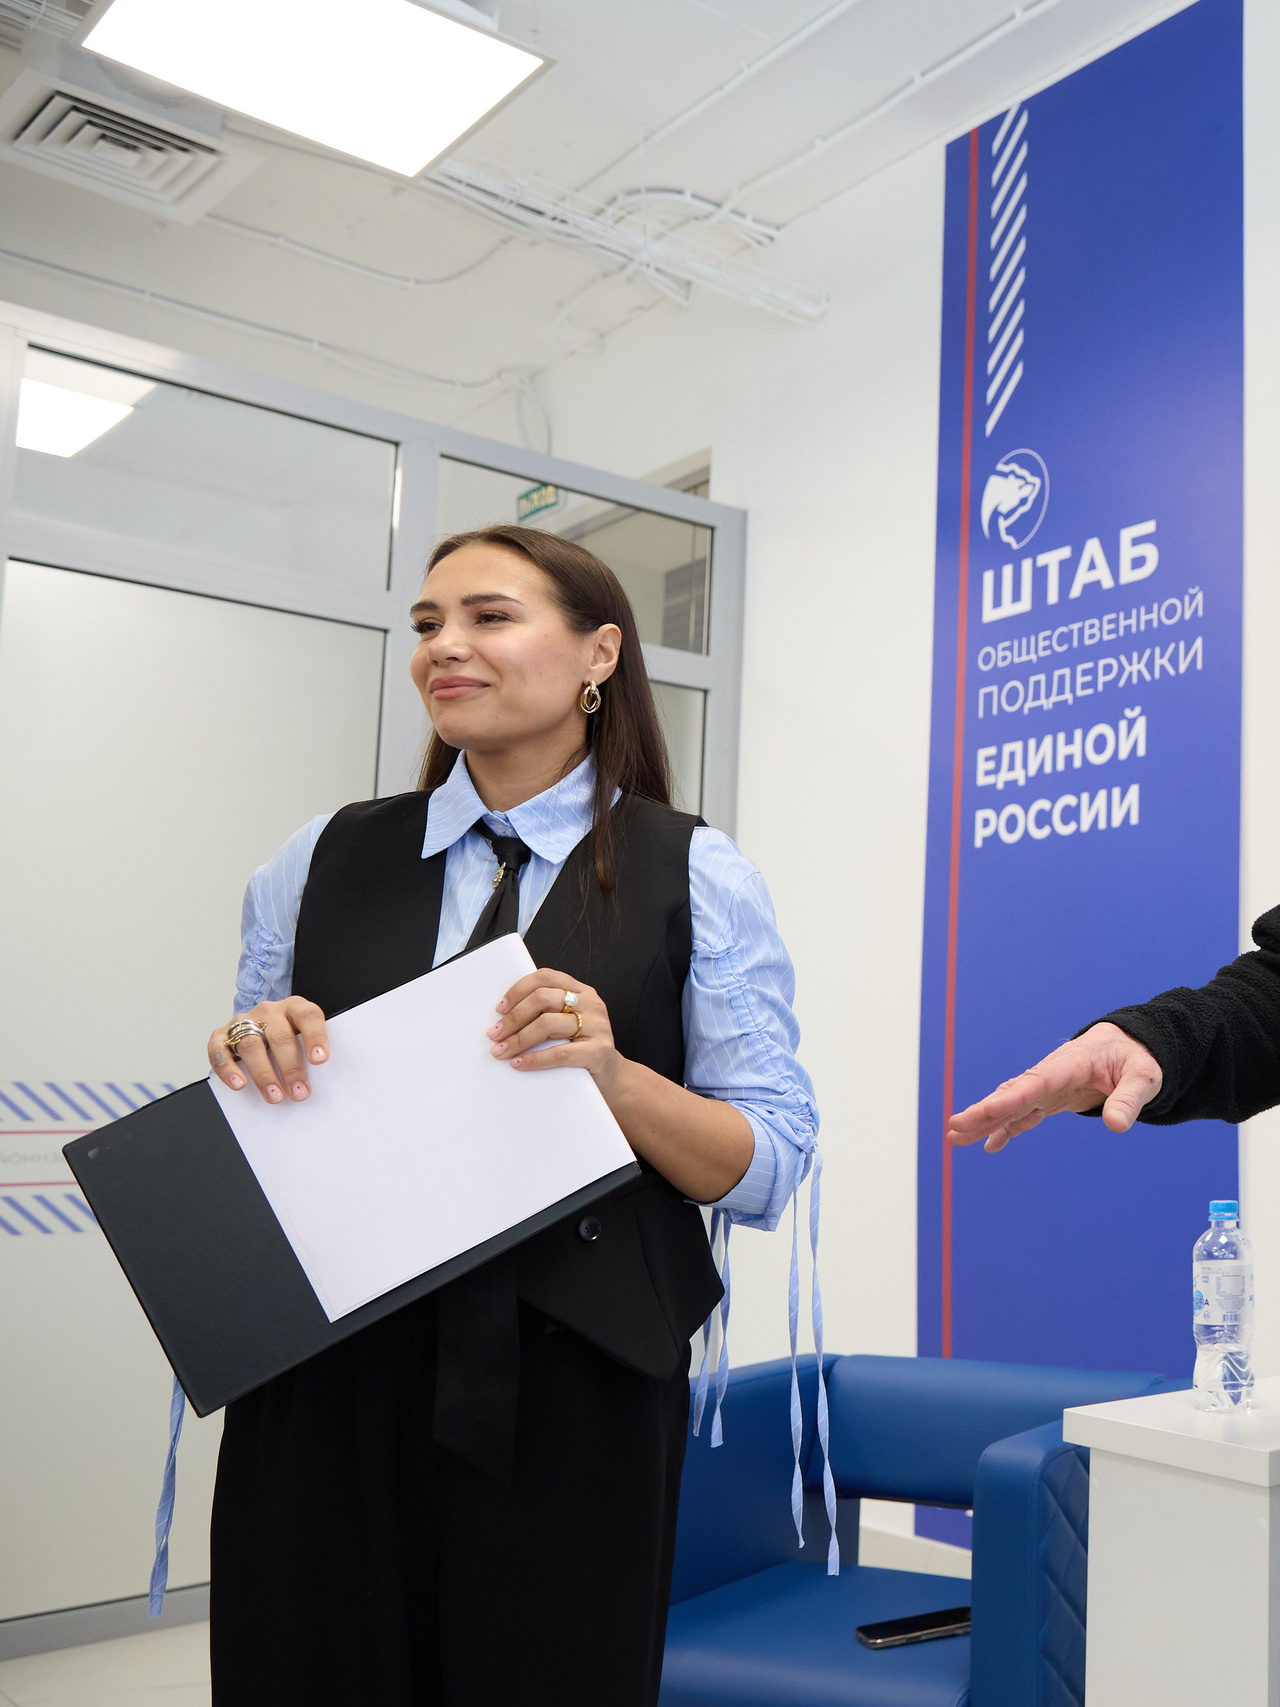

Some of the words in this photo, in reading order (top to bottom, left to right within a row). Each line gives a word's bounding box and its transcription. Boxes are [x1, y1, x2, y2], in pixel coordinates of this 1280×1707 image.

[981, 519, 1161, 625] ШТАБ
[977, 586, 1204, 672] ОБЩЕСТВЕННОЙ
[977, 636, 1204, 719] ПОДДЕРЖКИ
[975, 706, 1147, 790] ЕДИНОЙ
[974, 784, 1140, 848] РОССИИ
